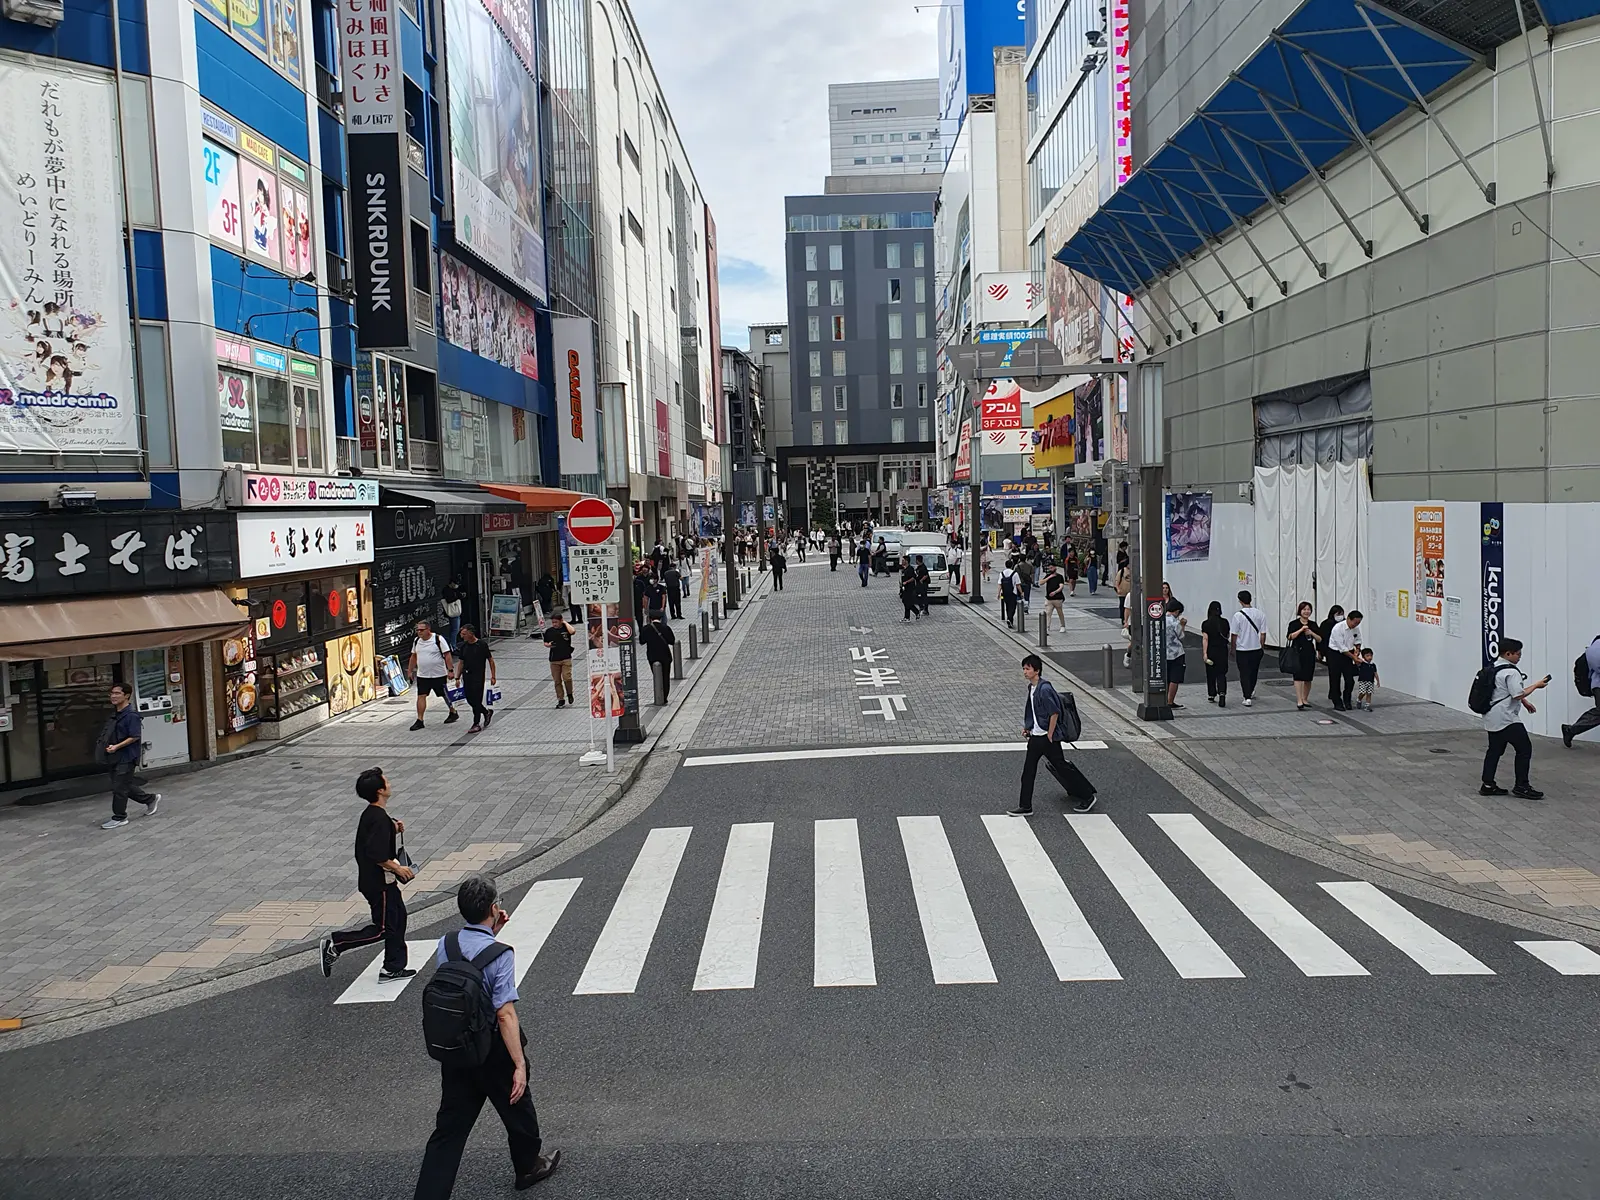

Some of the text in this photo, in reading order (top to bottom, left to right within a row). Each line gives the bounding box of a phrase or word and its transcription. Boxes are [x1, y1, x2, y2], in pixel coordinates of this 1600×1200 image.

[203, 112, 234, 139] RESTAURANT
[352, 114, 394, 126] 和ノ国7F
[246, 136, 268, 161] MAID CAFE
[204, 147, 220, 186] 2F
[40, 80, 74, 308] だれもが夢中になれる場所
[222, 199, 238, 236] 3F
[17, 172, 44, 306] めいどりーみん
[366, 173, 392, 312] SNKRDUNK
[20, 391, 117, 408] maidreamin
[378, 385, 386, 404] 3F
[568, 349, 584, 444] GAMERS
[394, 372, 404, 460] トレカ販売
[986, 402, 1016, 414] アコム
[380, 421, 388, 440] 2F
[984, 420, 1012, 428] 3F 入口
[260, 482, 269, 497] 2F
[271, 482, 280, 497] 3F
[318, 482, 356, 500] maidreamin
[1001, 482, 1050, 492] アクセス
[1416, 511, 1442, 522] amiami
[356, 523, 365, 536] 24
[286, 524, 338, 558] 富士そば
[356, 540, 366, 552] 時間
[0, 525, 204, 583] 富士そば
[1488, 566, 1502, 659] kuboco
